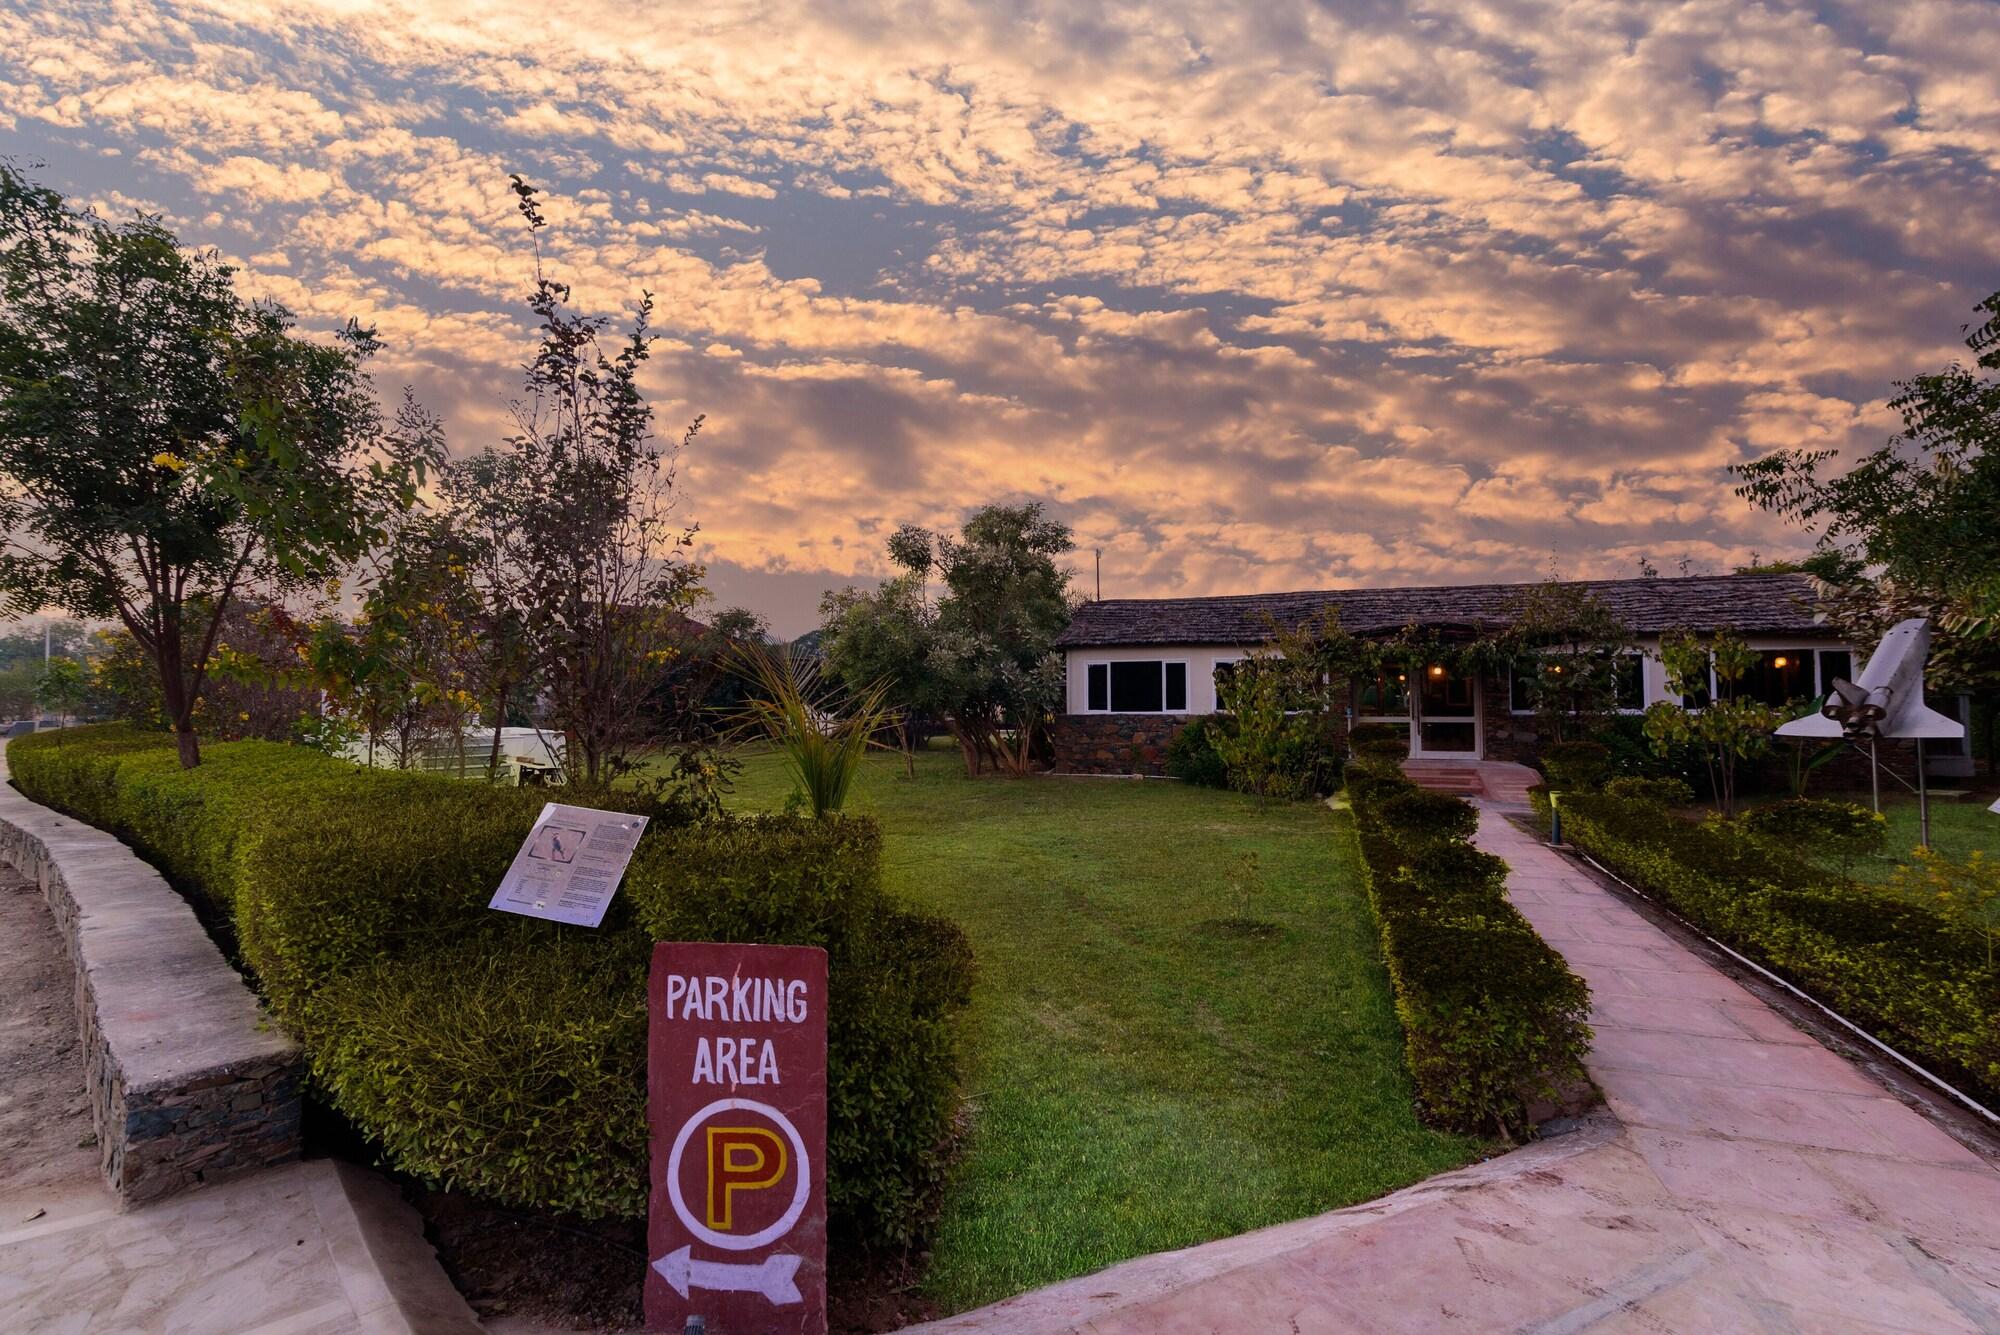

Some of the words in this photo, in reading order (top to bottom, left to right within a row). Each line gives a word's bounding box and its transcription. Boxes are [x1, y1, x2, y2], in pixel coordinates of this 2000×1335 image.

[666, 975, 807, 1024] PARKING
[692, 1037, 780, 1085] AREA
[707, 1126, 787, 1229] P
